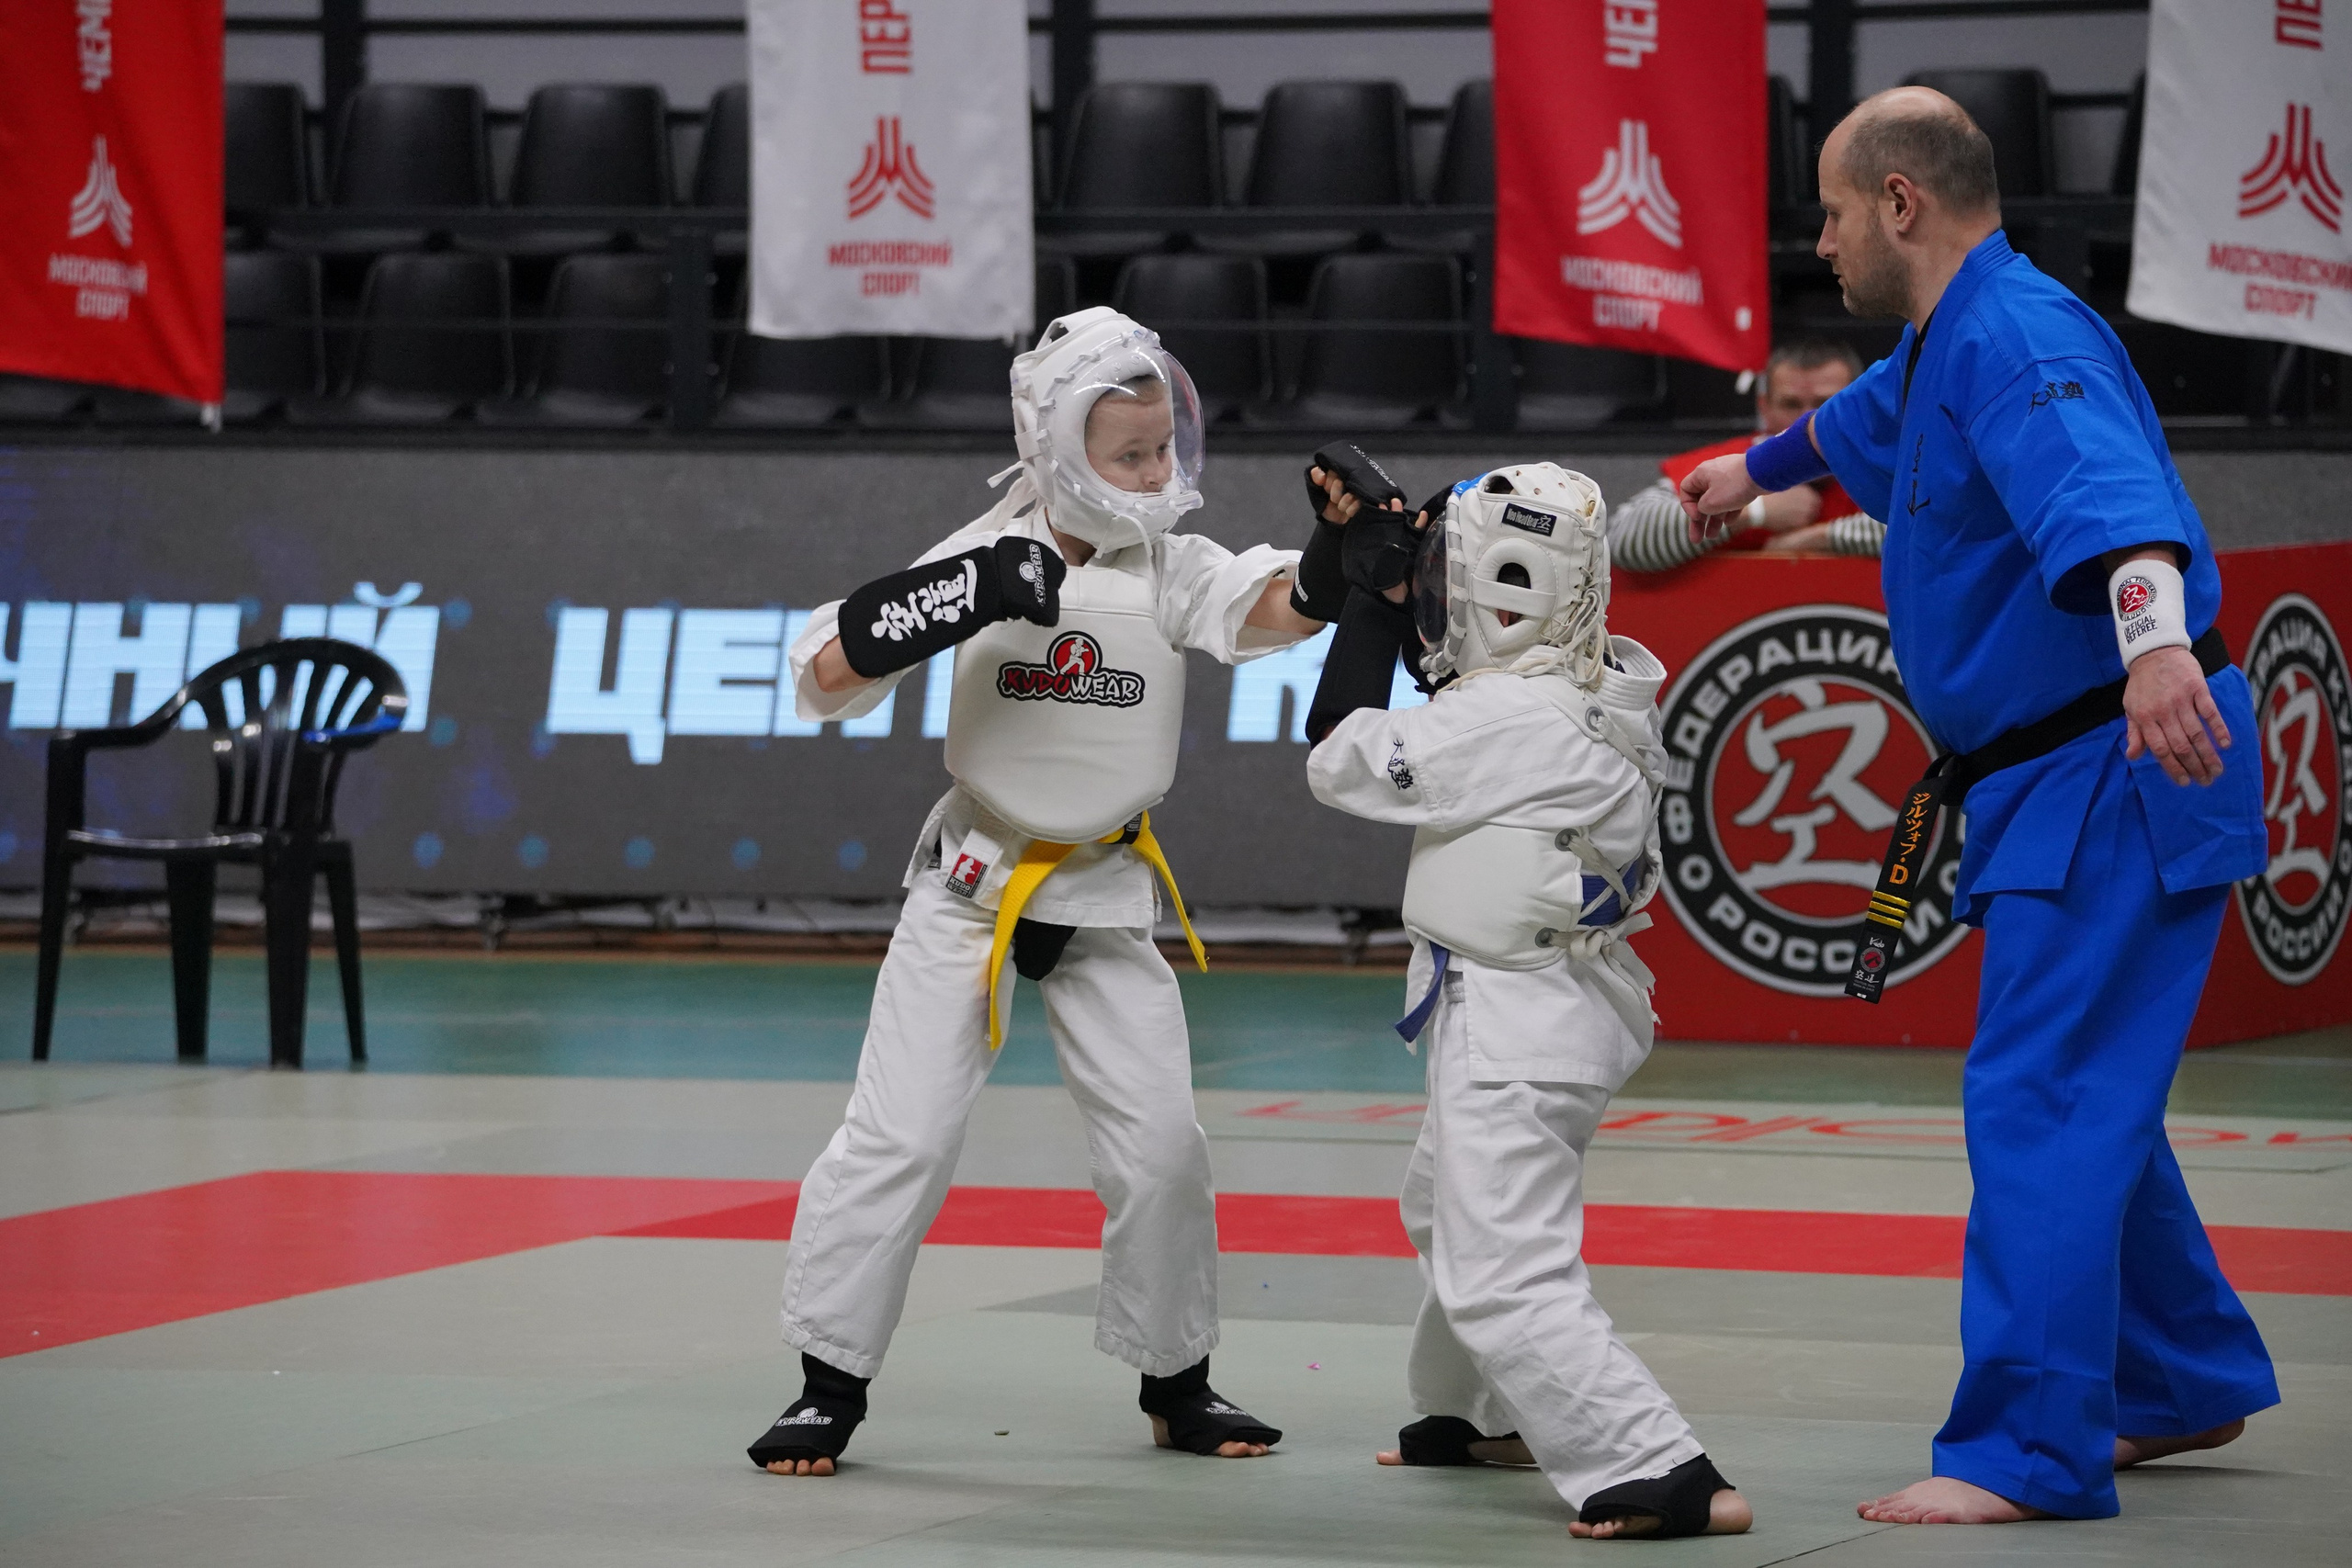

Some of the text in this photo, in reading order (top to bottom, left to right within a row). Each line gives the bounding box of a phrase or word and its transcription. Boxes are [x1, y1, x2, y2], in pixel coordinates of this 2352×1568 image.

[828, 236, 953, 268] МОСКОВСКИЙ
[861, 272, 920, 298] СПОРТ
[1561, 255, 1703, 307] МОСКОВСКИЙ
[76, 288, 130, 321] СПОРТ
[1593, 295, 1664, 333] СПОРТ
[2245, 282, 2316, 321] СПОРТ
[2123, 614, 2156, 637] OFFICIAL
[2125, 620, 2157, 645] REFEREE
[1003, 668, 1139, 704] KUDOWEAR
[949, 876, 971, 891] KUDO
[1698, 891, 1946, 972] РОССИ
